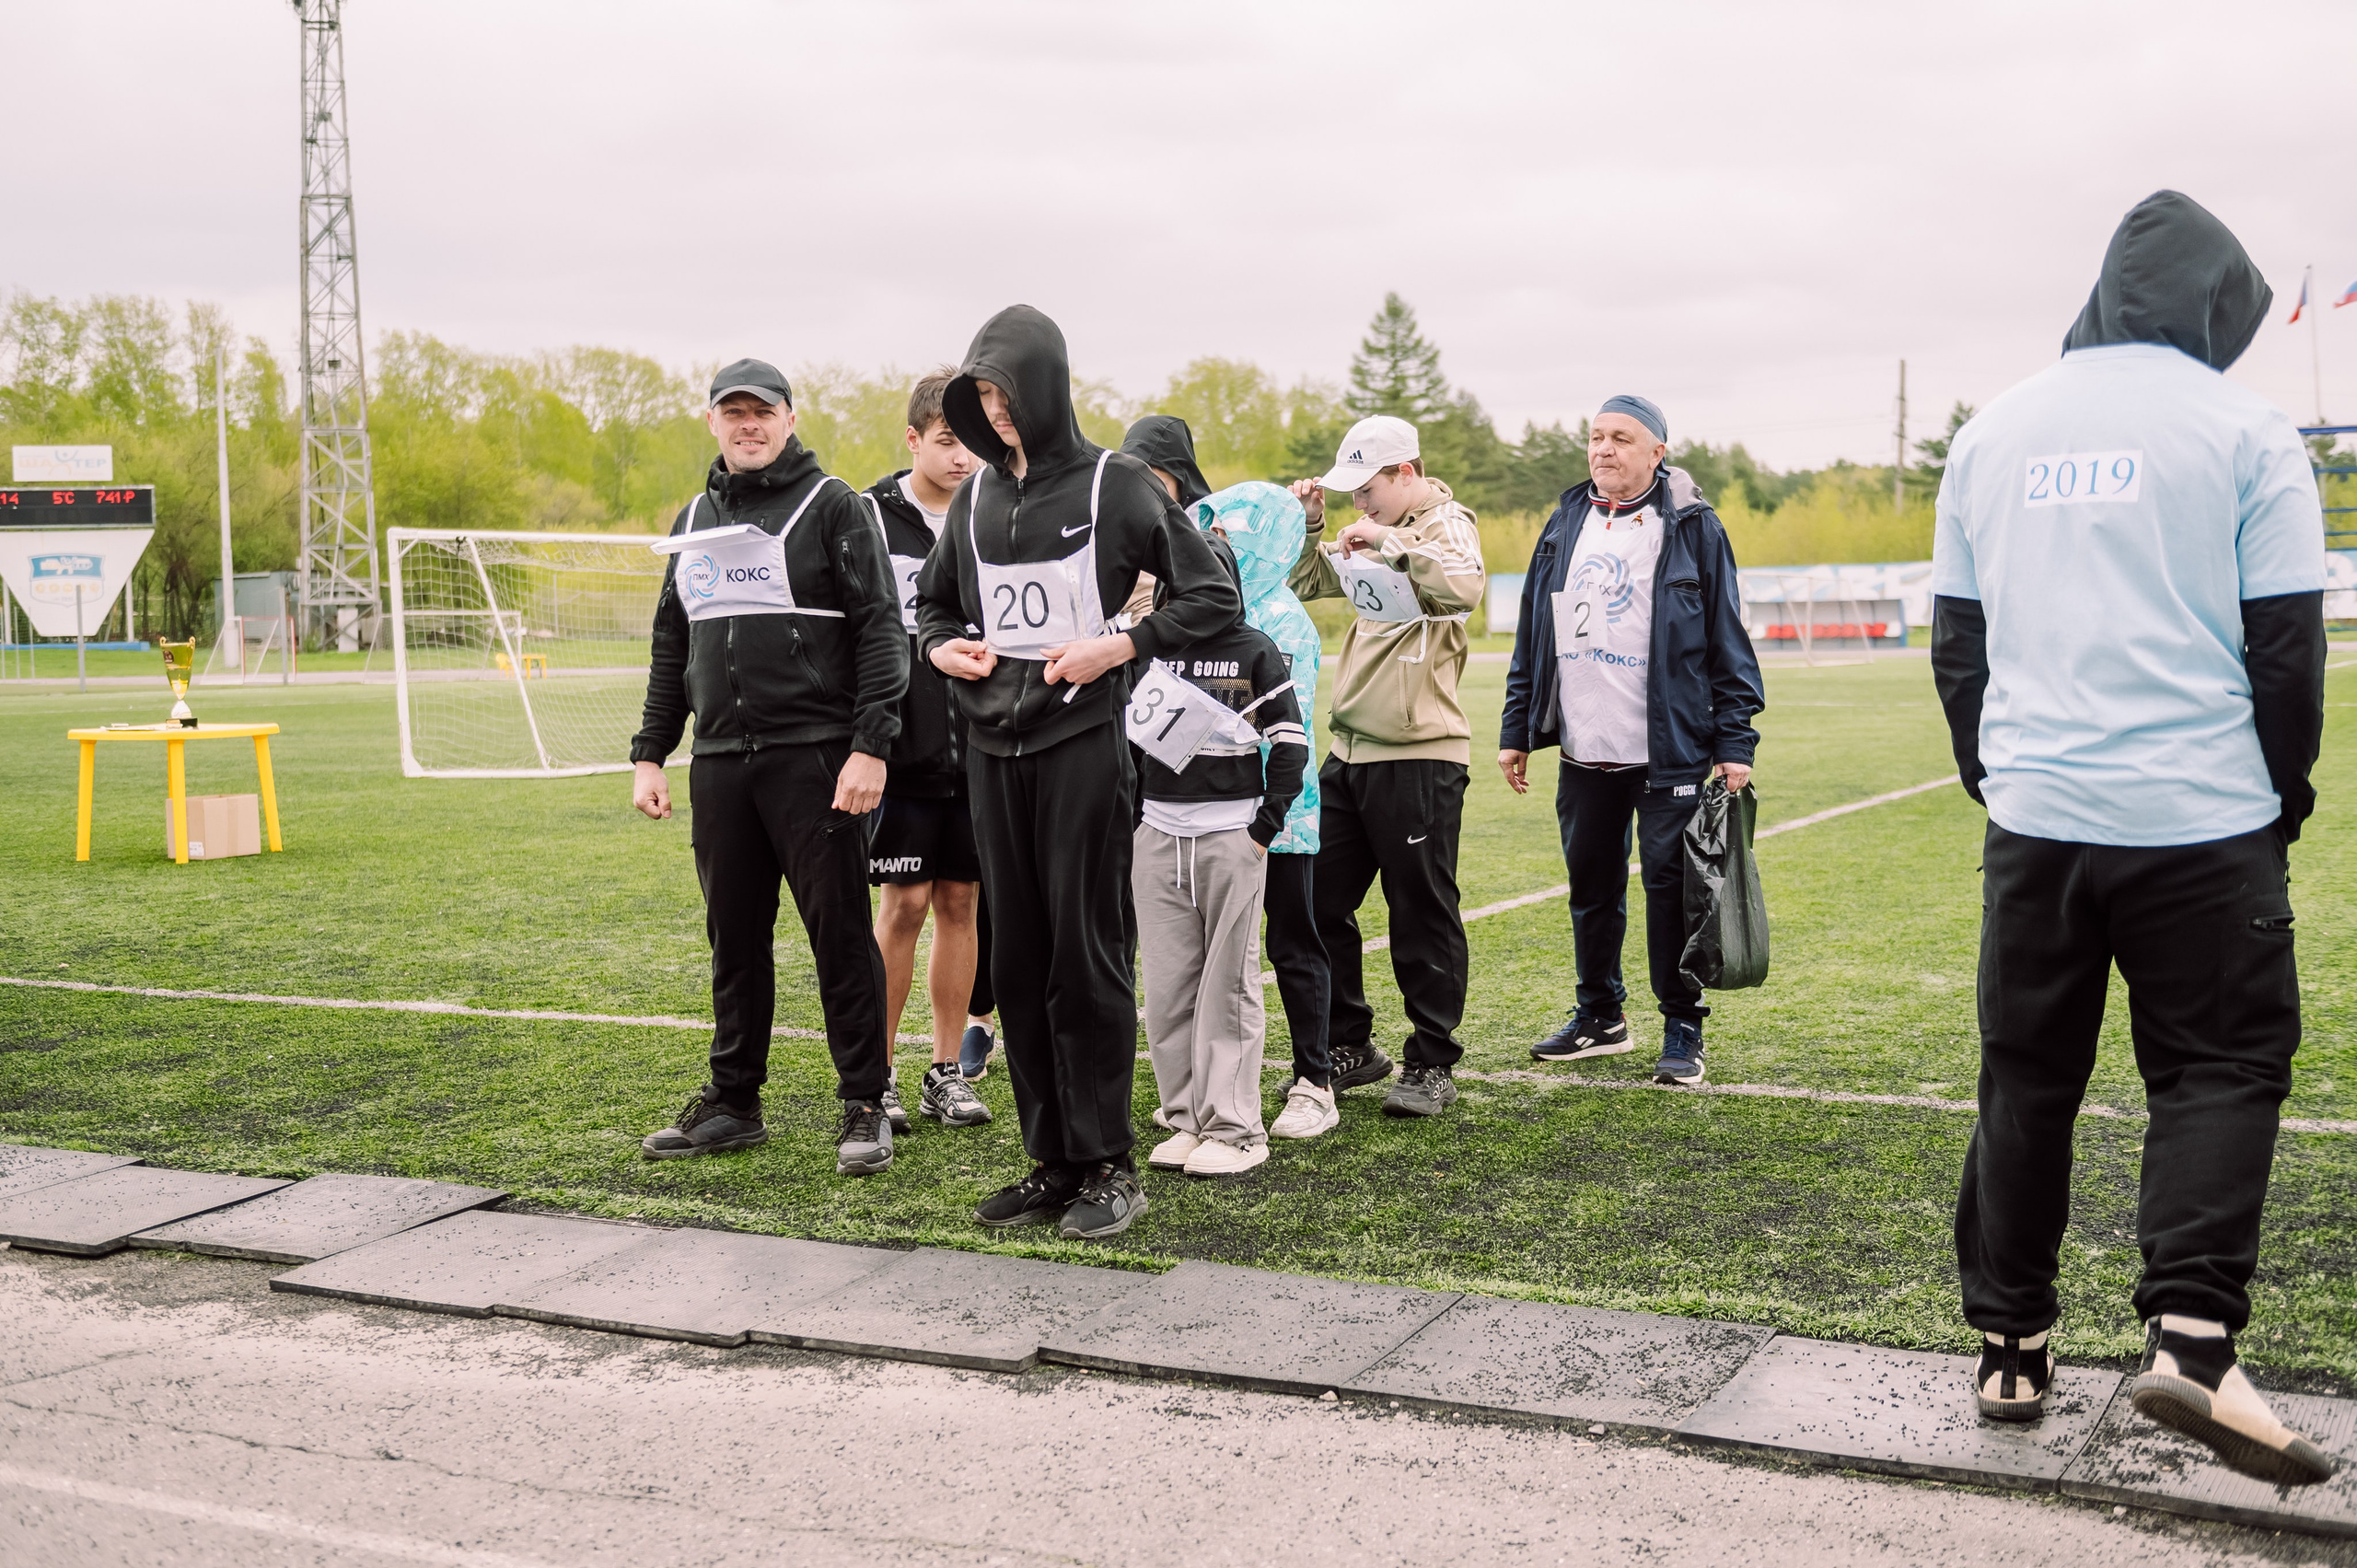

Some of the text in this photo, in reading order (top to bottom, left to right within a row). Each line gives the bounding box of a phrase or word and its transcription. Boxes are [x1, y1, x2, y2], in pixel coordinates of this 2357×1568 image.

[2027, 457, 2135, 501] 2019
[692, 566, 771, 583] ПМХ КОКС
[993, 581, 1050, 632] 20
[1344, 575, 1384, 612] 23
[1573, 601, 1591, 639] 2
[1192, 660, 1239, 678] GOING
[1132, 687, 1187, 743] 31
[869, 856, 923, 874] MANTO
